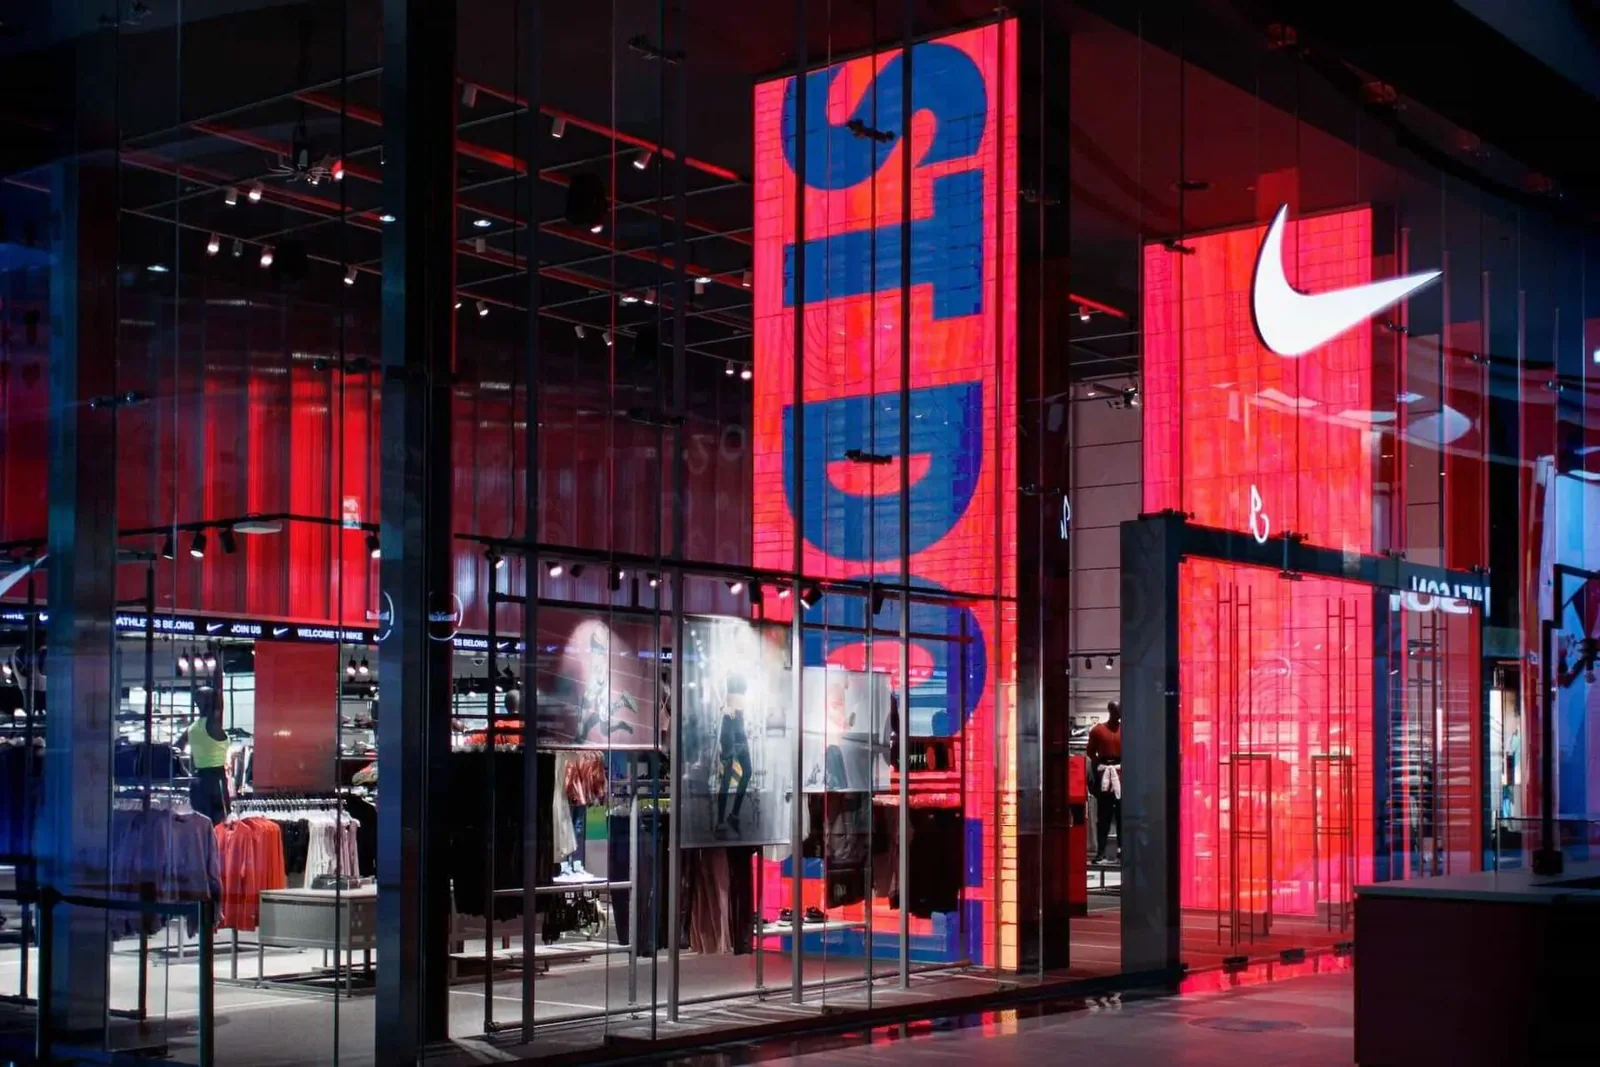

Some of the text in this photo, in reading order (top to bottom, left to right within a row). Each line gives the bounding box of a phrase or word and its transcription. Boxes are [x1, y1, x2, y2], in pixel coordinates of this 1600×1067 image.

[115, 617, 161, 628] ATHLES
[230, 624, 262, 635] JOIN US
[297, 627, 334, 639] WELCOME
[345, 631, 363, 640] NIKE
[463, 639, 488, 649] BELONG
